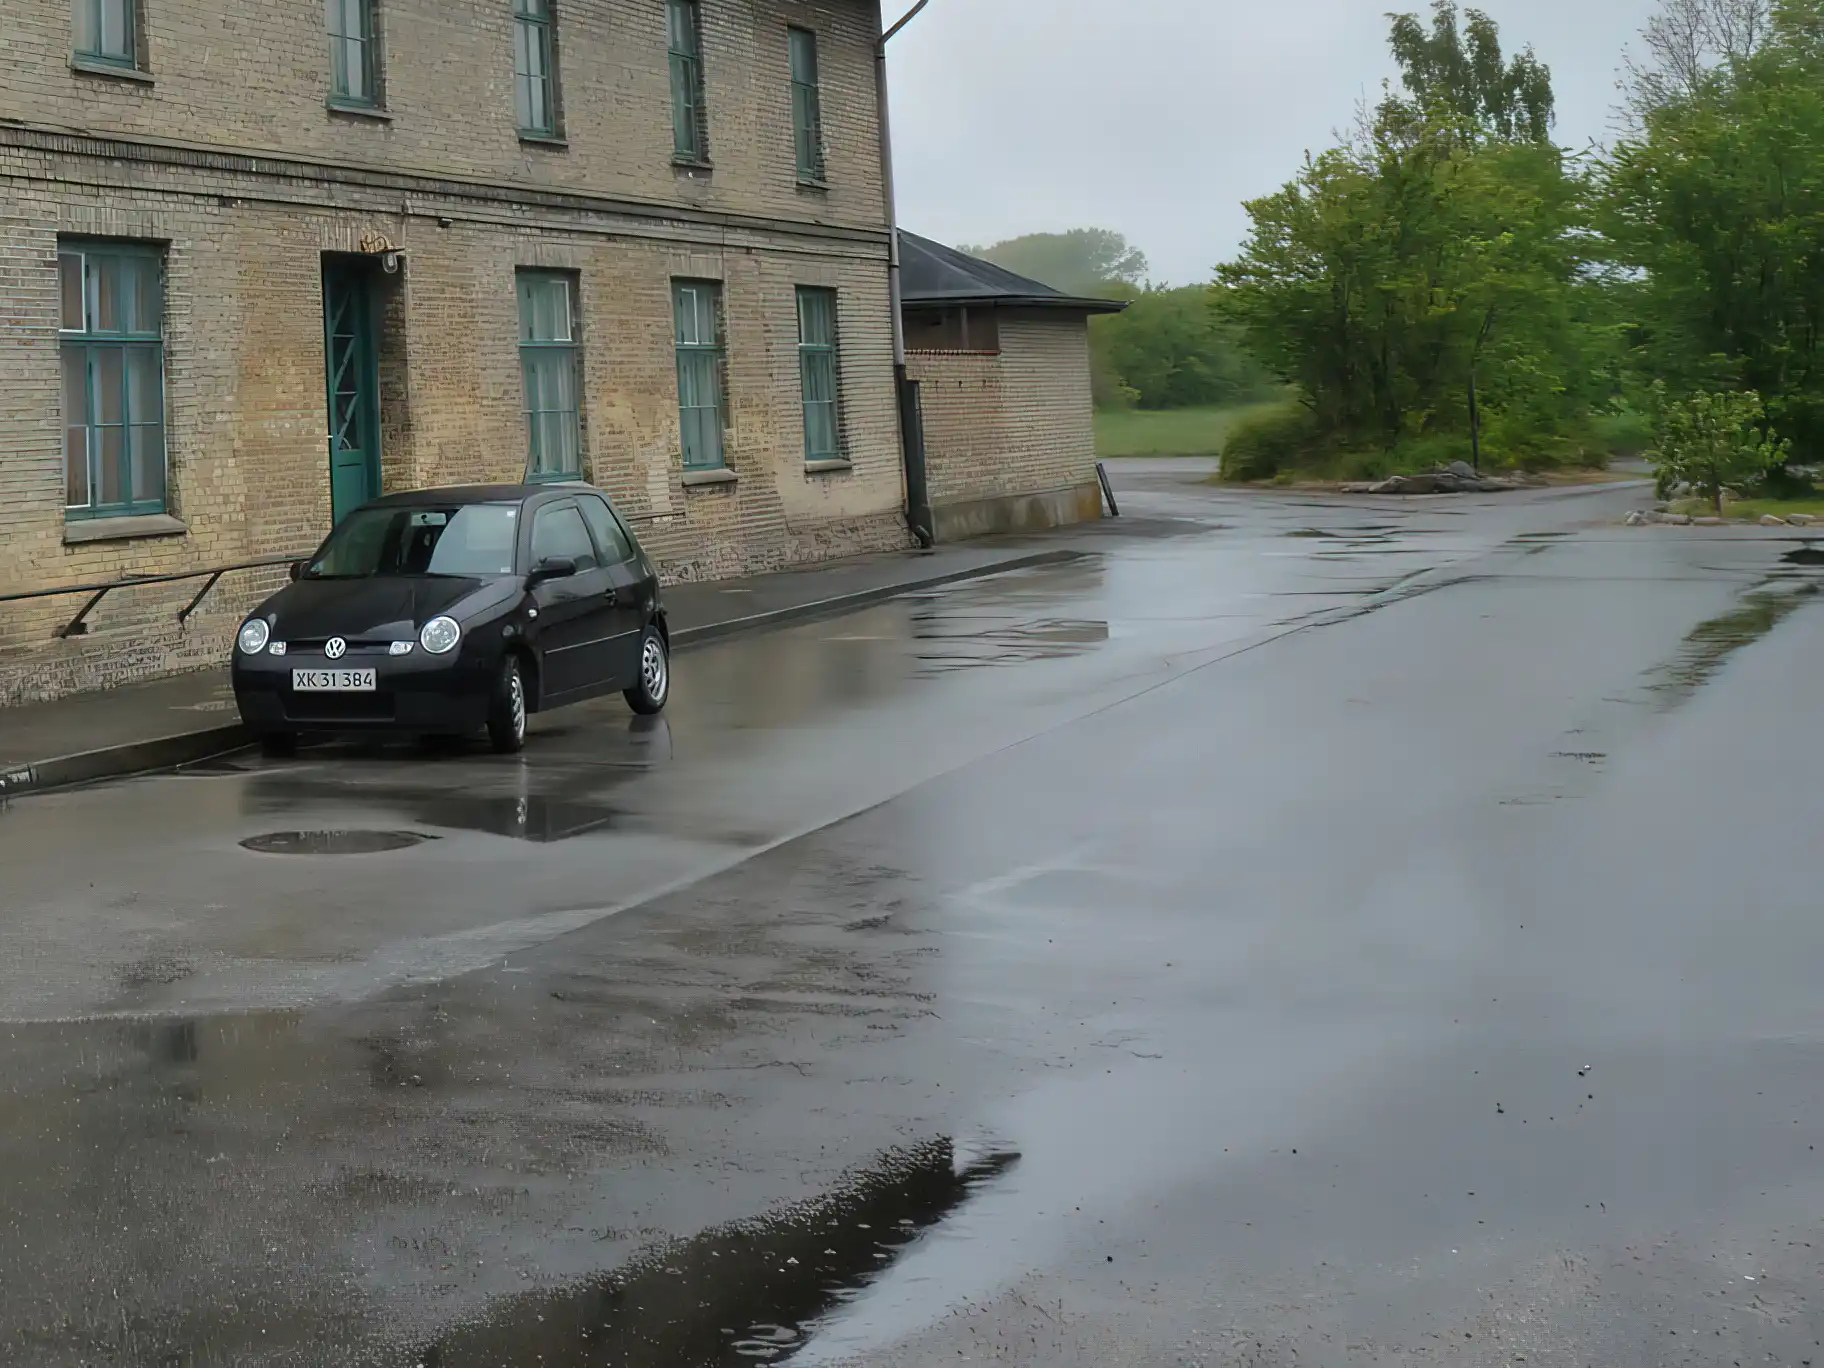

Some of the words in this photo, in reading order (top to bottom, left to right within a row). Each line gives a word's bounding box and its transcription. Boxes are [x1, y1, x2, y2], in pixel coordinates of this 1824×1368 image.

[296, 672, 317, 687] XK
[320, 672, 336, 687] 31
[342, 672, 373, 687] 384
